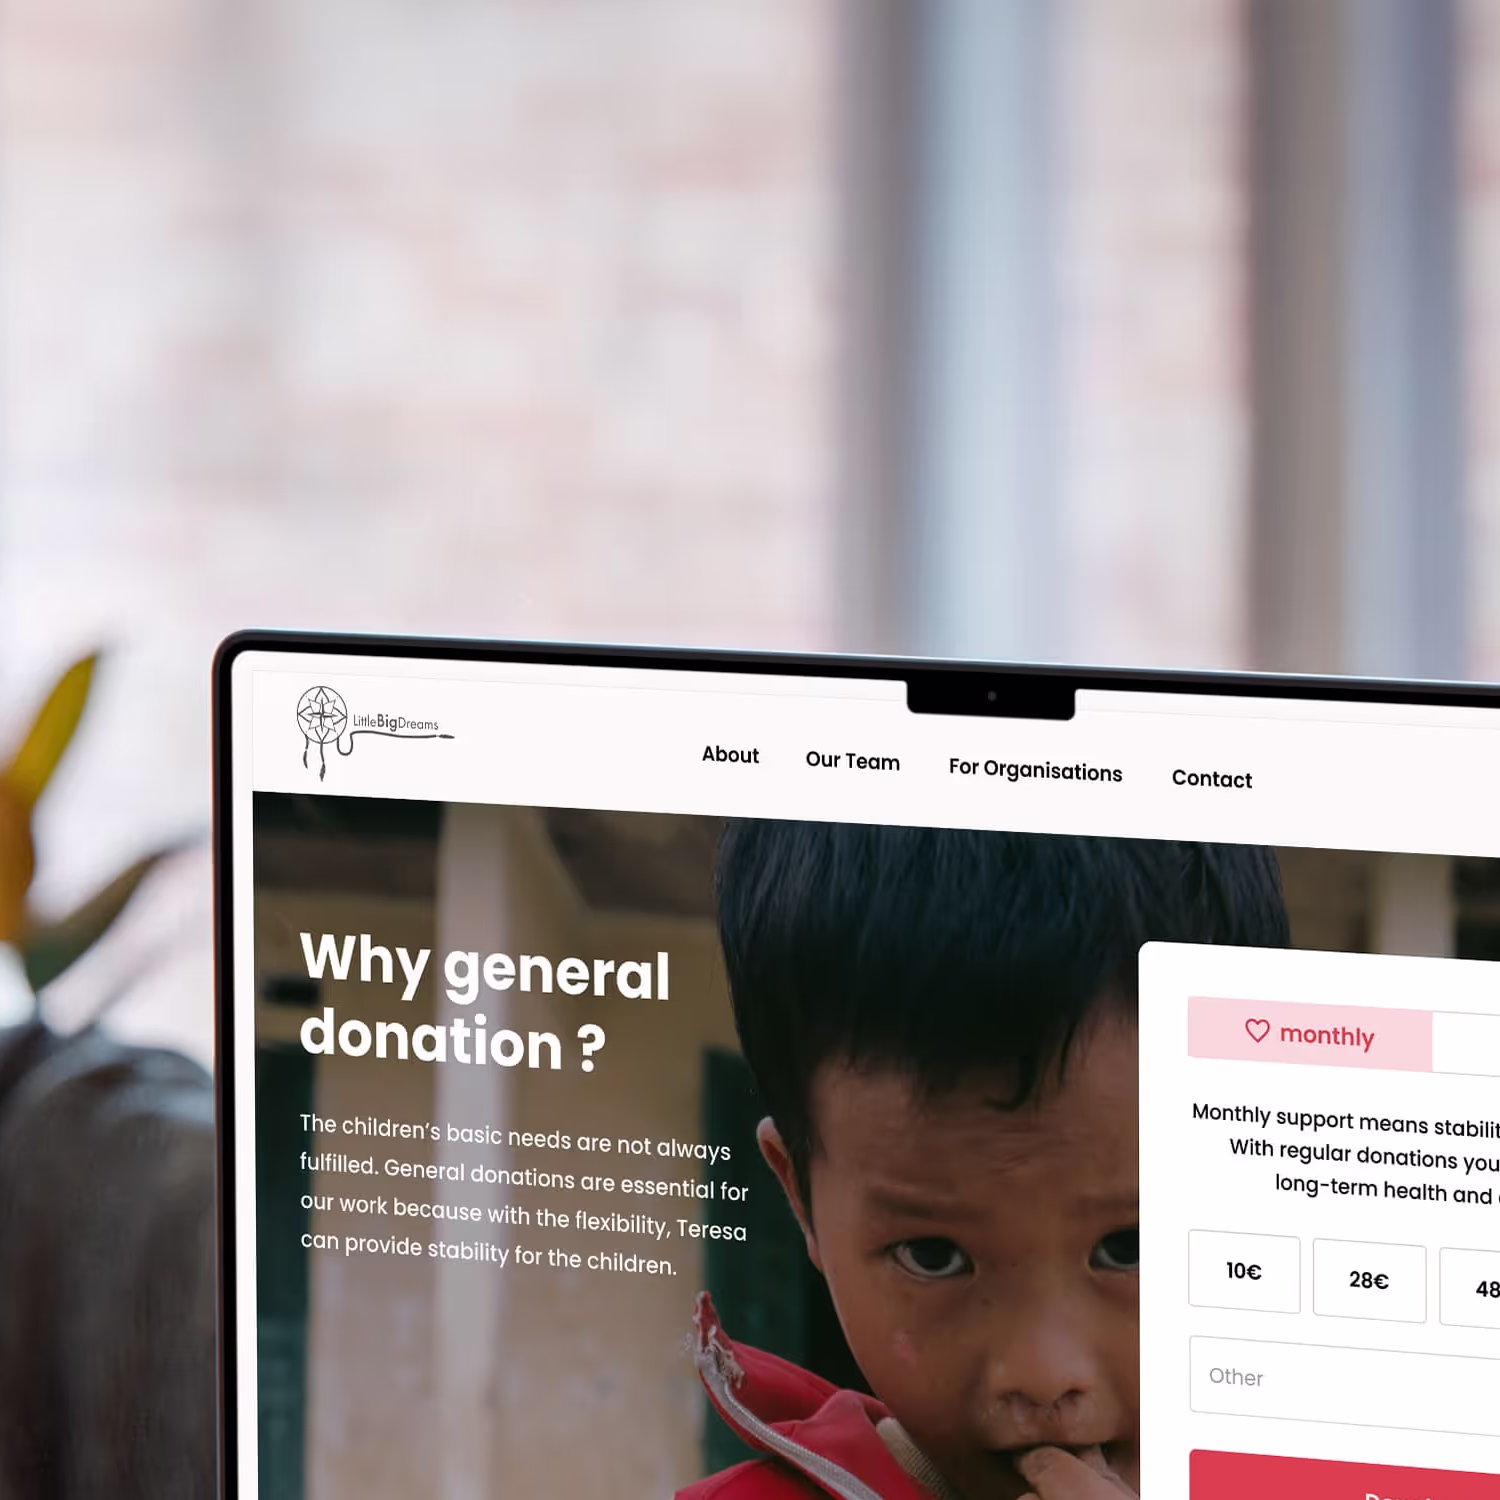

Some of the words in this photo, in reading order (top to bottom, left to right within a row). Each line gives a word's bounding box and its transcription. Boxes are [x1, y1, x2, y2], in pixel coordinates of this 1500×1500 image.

[702, 744, 760, 764] About
[805, 750, 842, 769] Our
[845, 752, 900, 772] Team
[949, 757, 980, 775] For
[983, 759, 1123, 783] Organisations
[1172, 768, 1253, 789] Contact
[299, 932, 431, 1001] Why
[443, 950, 669, 1006] general
[300, 1006, 562, 1070] donation
[577, 1023, 606, 1073] ?
[1280, 1026, 1375, 1054] monthly
[1192, 1102, 1272, 1129] Monthly
[1276, 1111, 1354, 1133] support
[1359, 1116, 1429, 1135] means
[300, 1113, 337, 1133] The
[447, 1122, 502, 1145] basic
[508, 1130, 571, 1150] needs
[577, 1136, 611, 1153] are
[618, 1138, 651, 1155] not
[657, 1138, 731, 1165] always
[1229, 1137, 1274, 1157] With
[1280, 1143, 1352, 1165] regular
[1356, 1146, 1458, 1170] donations
[1463, 1156, 1500, 1176] you
[300, 1151, 379, 1175] fulfilled.
[384, 1159, 465, 1182] General
[470, 1163, 575, 1189] donations
[581, 1176, 615, 1192] are
[621, 1179, 714, 1199] essential
[721, 1181, 749, 1201] for
[1275, 1173, 1378, 1199] long-term
[1384, 1180, 1448, 1202] health
[1452, 1187, 1493, 1206] and
[301, 1195, 334, 1211] our
[339, 1196, 388, 1215] work
[394, 1197, 483, 1222] because
[487, 1204, 530, 1225] with
[536, 1208, 570, 1228] the
[575, 1210, 671, 1241] flexibility,
[676, 1219, 746, 1241] Teresa
[301, 1233, 339, 1250] can
[345, 1235, 423, 1257] provide
[428, 1240, 510, 1269] stability
[515, 1245, 543, 1265] for
[547, 1248, 582, 1268] the
[587, 1252, 677, 1275] children.
[1226, 1261, 1262, 1281] 10€
[1349, 1270, 1390, 1290] 28€
[1209, 1367, 1264, 1387] Other
